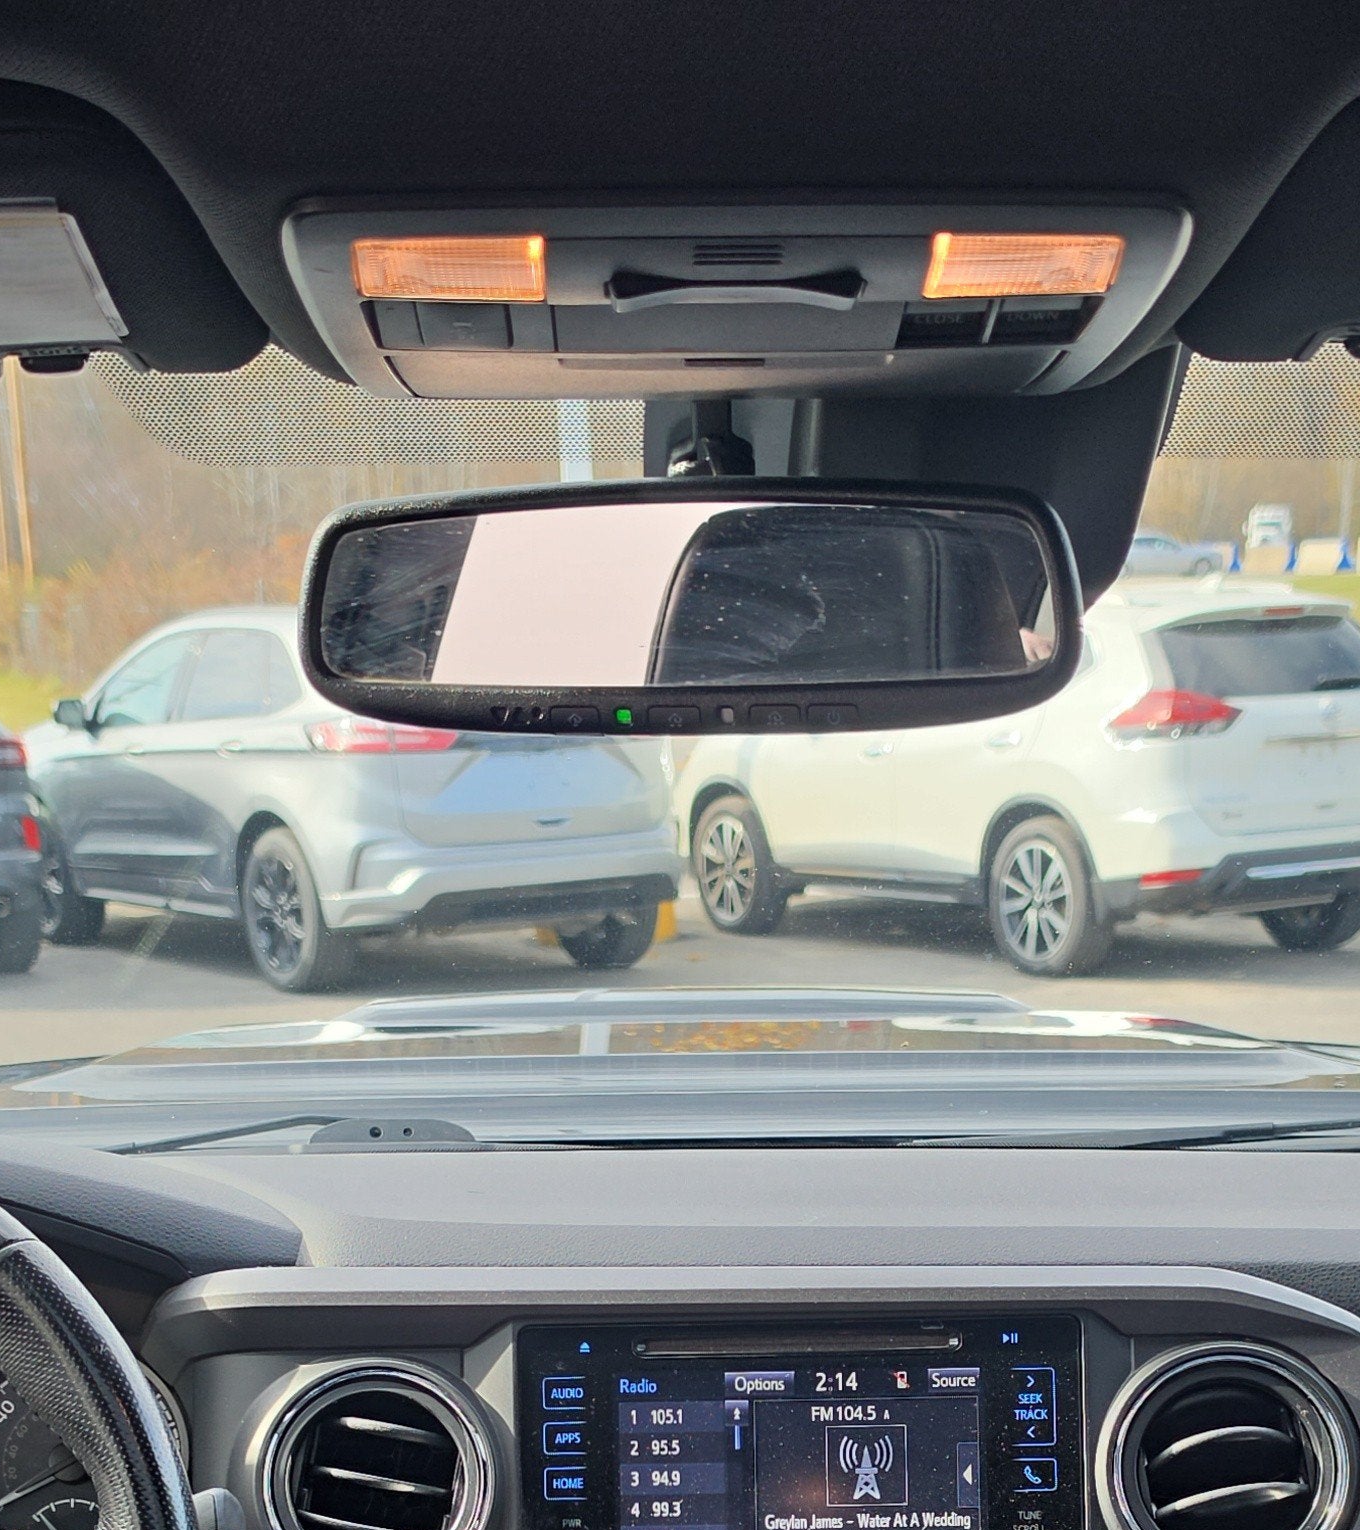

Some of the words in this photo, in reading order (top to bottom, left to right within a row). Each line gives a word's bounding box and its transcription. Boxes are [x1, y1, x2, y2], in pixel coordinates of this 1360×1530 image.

[619, 1378, 658, 1394] Radio
[734, 1376, 785, 1394] Options
[815, 1372, 858, 1392] 2:14
[932, 1374, 976, 1388] Source
[550, 1387, 584, 1399] AUDIO
[1017, 1394, 1043, 1404] SEEK
[630, 1409, 637, 1425] 1
[650, 1408, 683, 1425] 105.1
[811, 1406, 834, 1422] FM
[836, 1405, 877, 1421] 104.5
[1014, 1408, 1048, 1421] TRACK
[554, 1432, 581, 1444] APPS
[630, 1440, 639, 1456] 2
[651, 1439, 680, 1456] 95.5
[552, 1477, 584, 1489] HOME
[630, 1471, 639, 1487] 3
[651, 1470, 681, 1487] 94.9
[630, 1502, 640, 1518] 4
[651, 1501, 682, 1518] 99.3
[1017, 1511, 1042, 1521] TUNE
[562, 1519, 581, 1528] PWR
[808, 1515, 843, 1530] James
[856, 1513, 891, 1529] Water
[893, 1513, 908, 1528] At
[909, 1513, 920, 1528] A
[922, 1512, 971, 1530] Wedding
